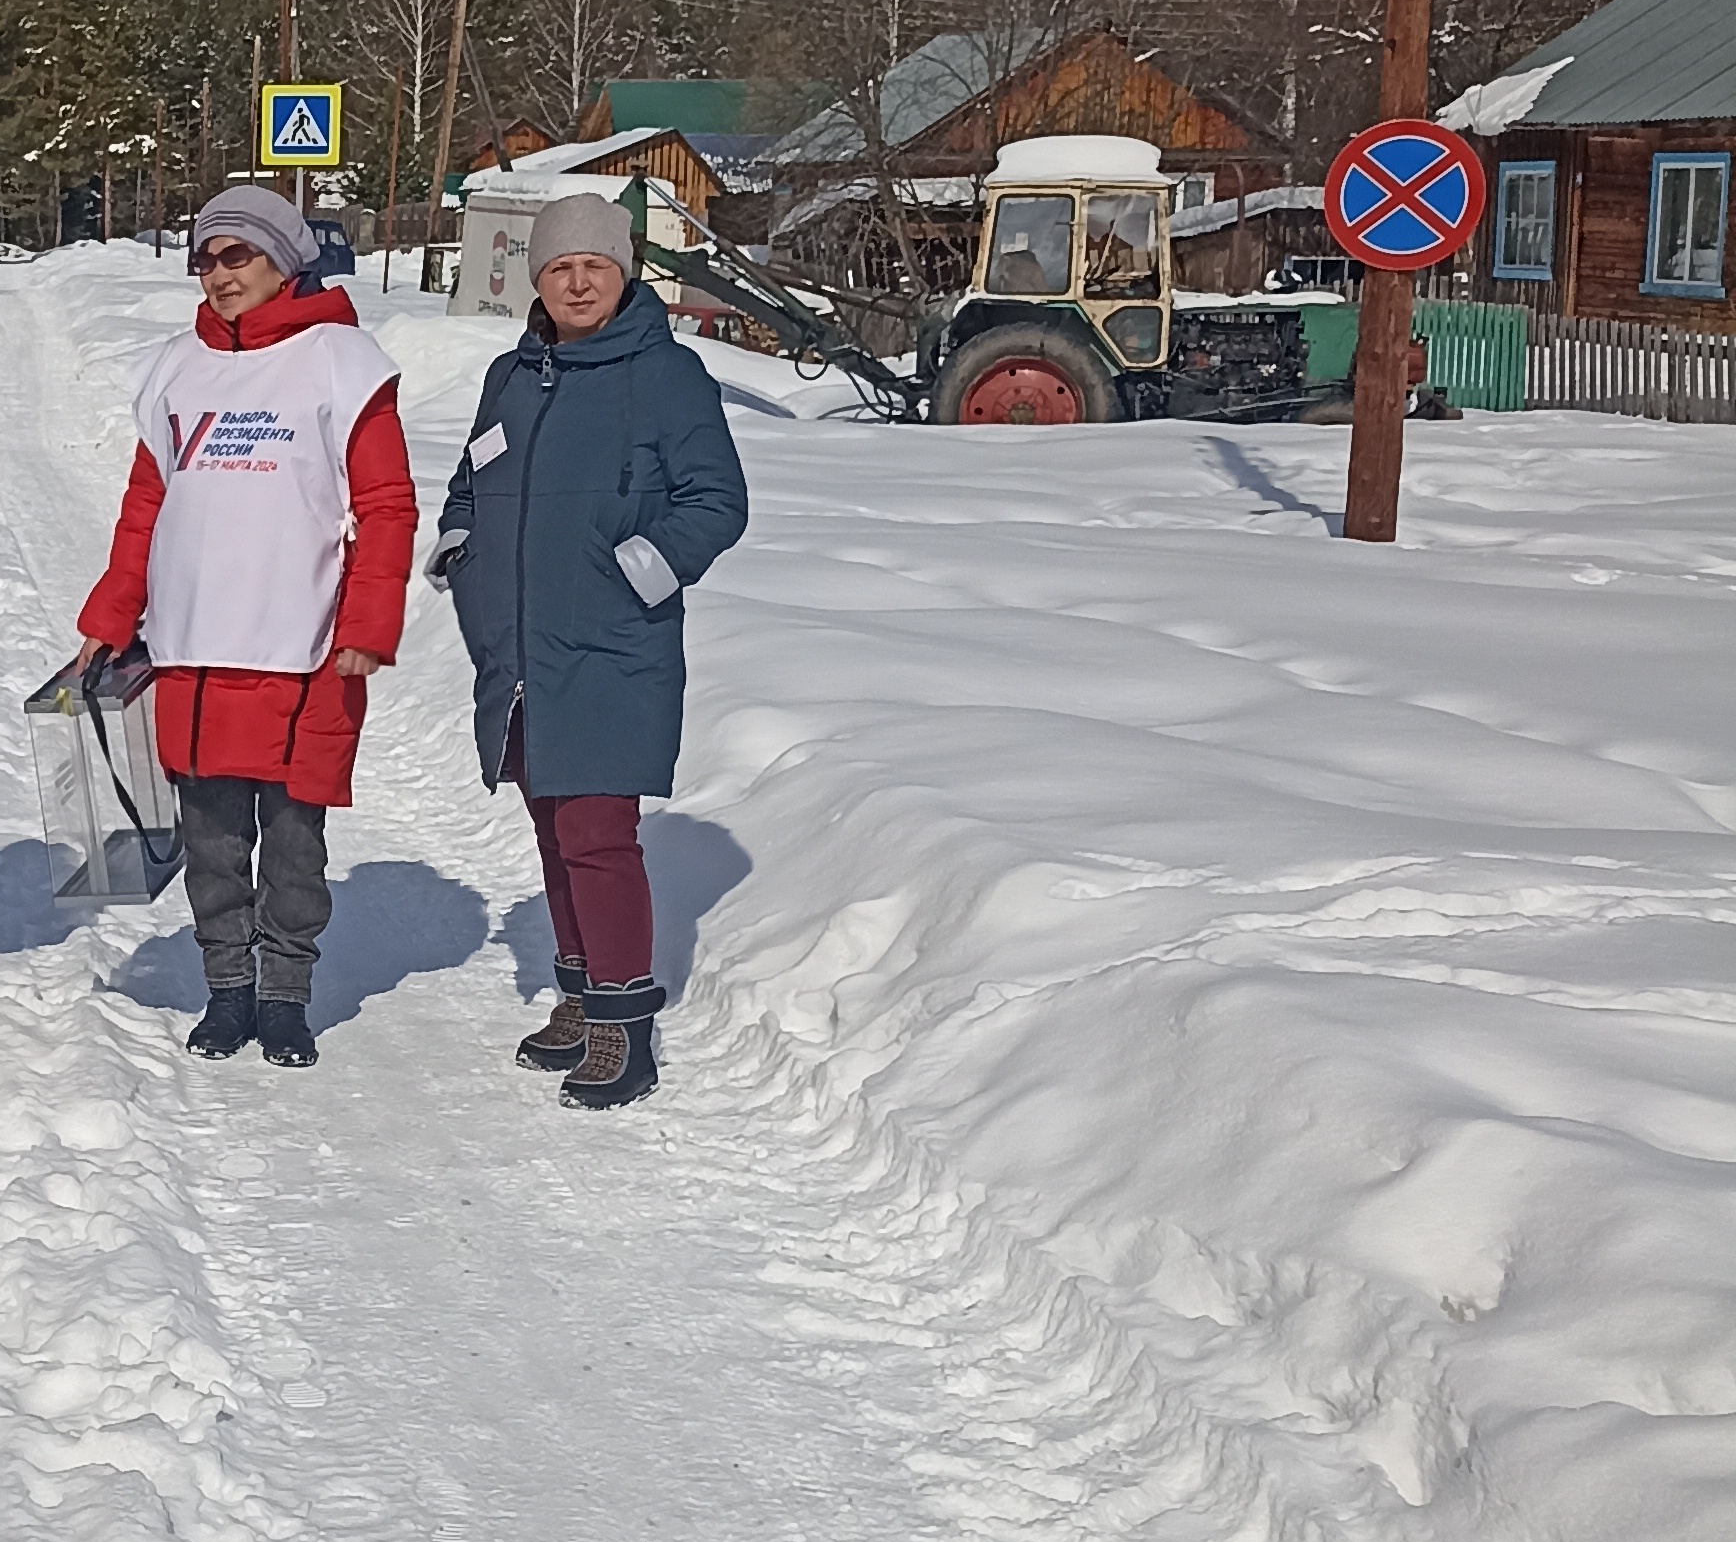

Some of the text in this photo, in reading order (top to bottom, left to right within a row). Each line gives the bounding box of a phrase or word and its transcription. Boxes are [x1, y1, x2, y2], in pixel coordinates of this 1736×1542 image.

[220, 411, 280, 424] ВЫБОРЫ
[211, 427, 295, 442] ПРЕЗИДЕНТА
[202, 444, 254, 457] РОССИИ
